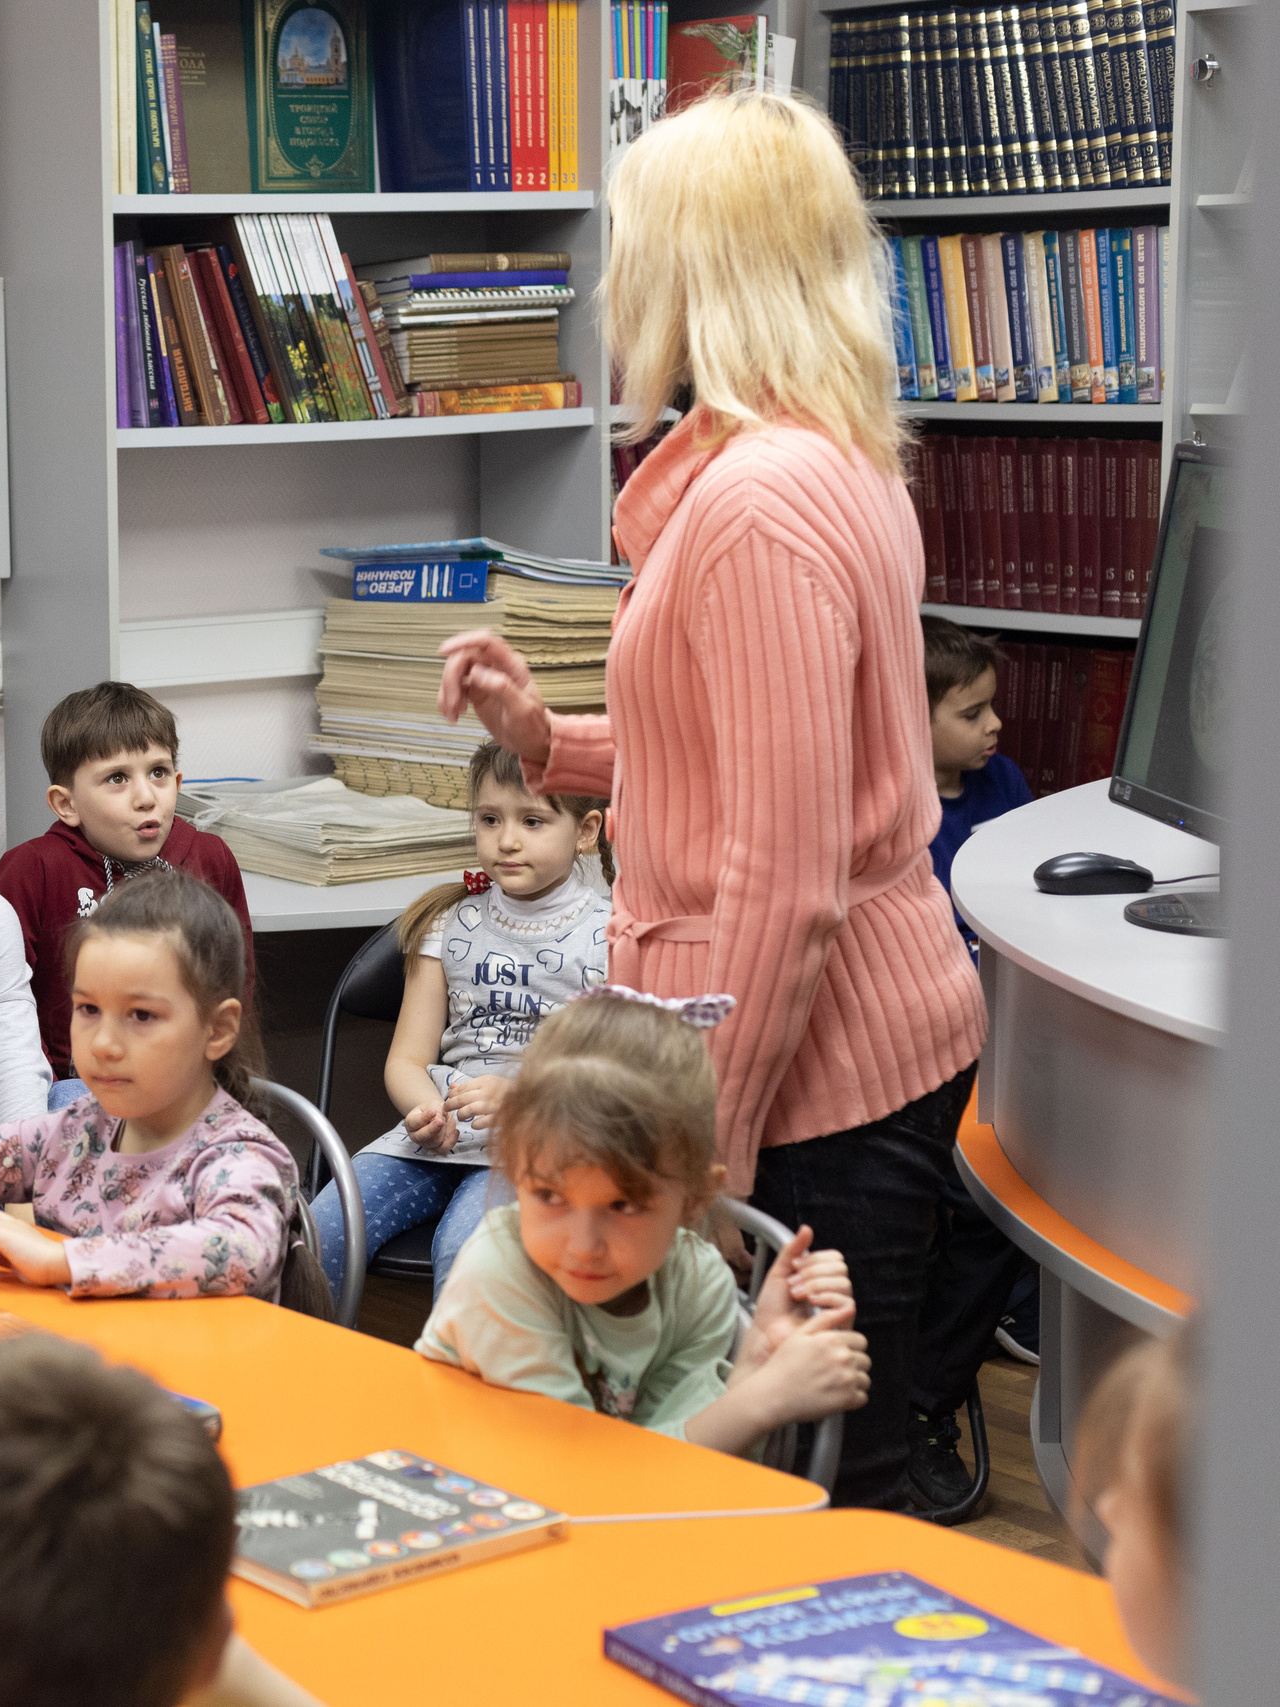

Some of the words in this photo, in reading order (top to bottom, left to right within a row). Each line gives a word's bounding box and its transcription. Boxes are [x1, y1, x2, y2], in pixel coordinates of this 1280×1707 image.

[1068, 58, 1085, 130] ЭНЦИКЛОПЕДИЯ
[1085, 57, 1100, 129] ЭНЦИКЛОПЕДИЯ
[1101, 52, 1118, 125] ЭНЦИКЛОПЕДИЯ
[1120, 52, 1136, 125] ЭНЦИКЛОПЕДИЯ
[1077, 151, 1088, 160] 15
[1093, 151, 1104, 160] 16
[1110, 146, 1120, 157] 17
[1127, 147, 1137, 157] 18
[1143, 145, 1154, 156] 19
[516, 173, 522, 185] 2
[528, 173, 534, 185] 2
[139, 278, 149, 310] Русская
[142, 312, 152, 351] любовная
[146, 353, 156, 390] классика
[172, 348, 193, 412] АНТОЛОГИЯ
[356, 570, 416, 582] ПОЗНАНИЯ
[369, 581, 414, 596] ДРЕВО
[472, 963, 534, 986] JUST
[490, 990, 541, 1015] FUN
